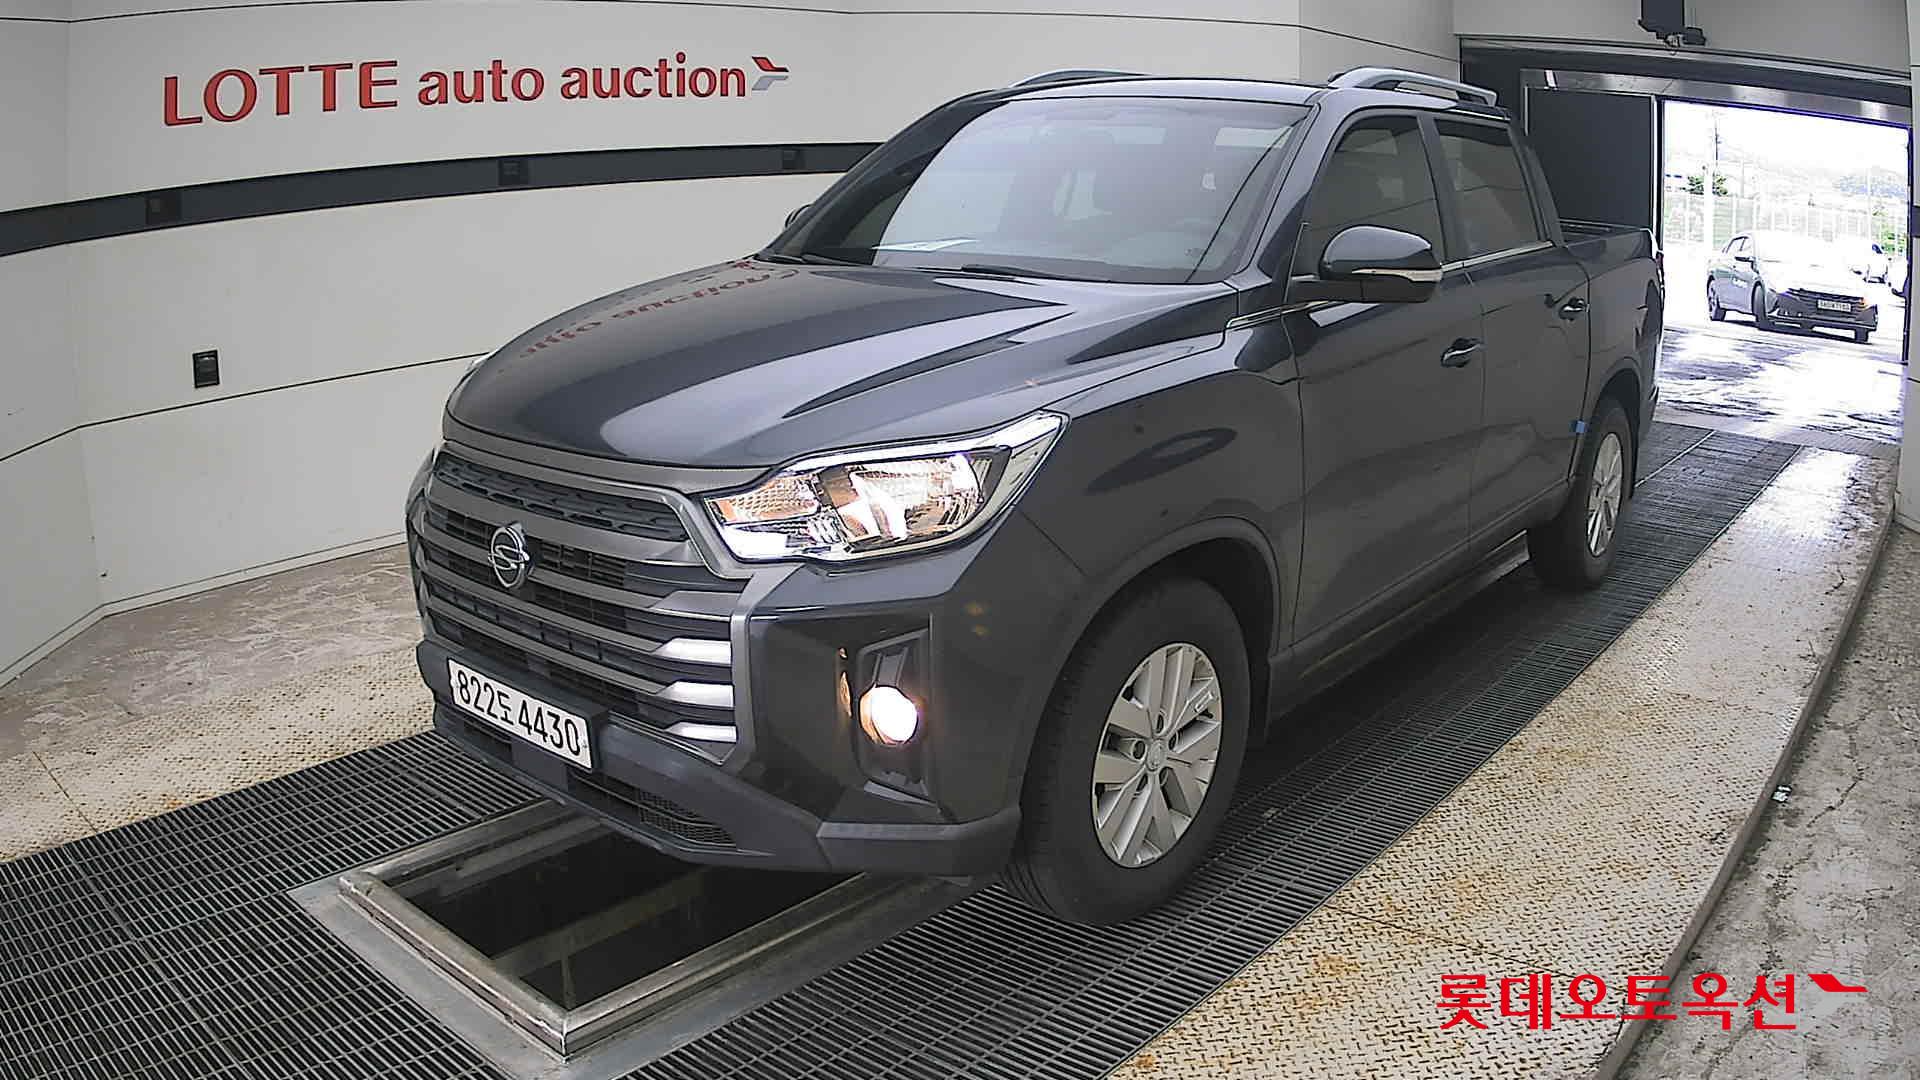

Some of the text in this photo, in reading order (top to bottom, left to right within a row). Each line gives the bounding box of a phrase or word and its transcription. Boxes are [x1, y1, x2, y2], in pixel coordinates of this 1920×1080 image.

[163, 51, 748, 127] LOTTE auto auction
